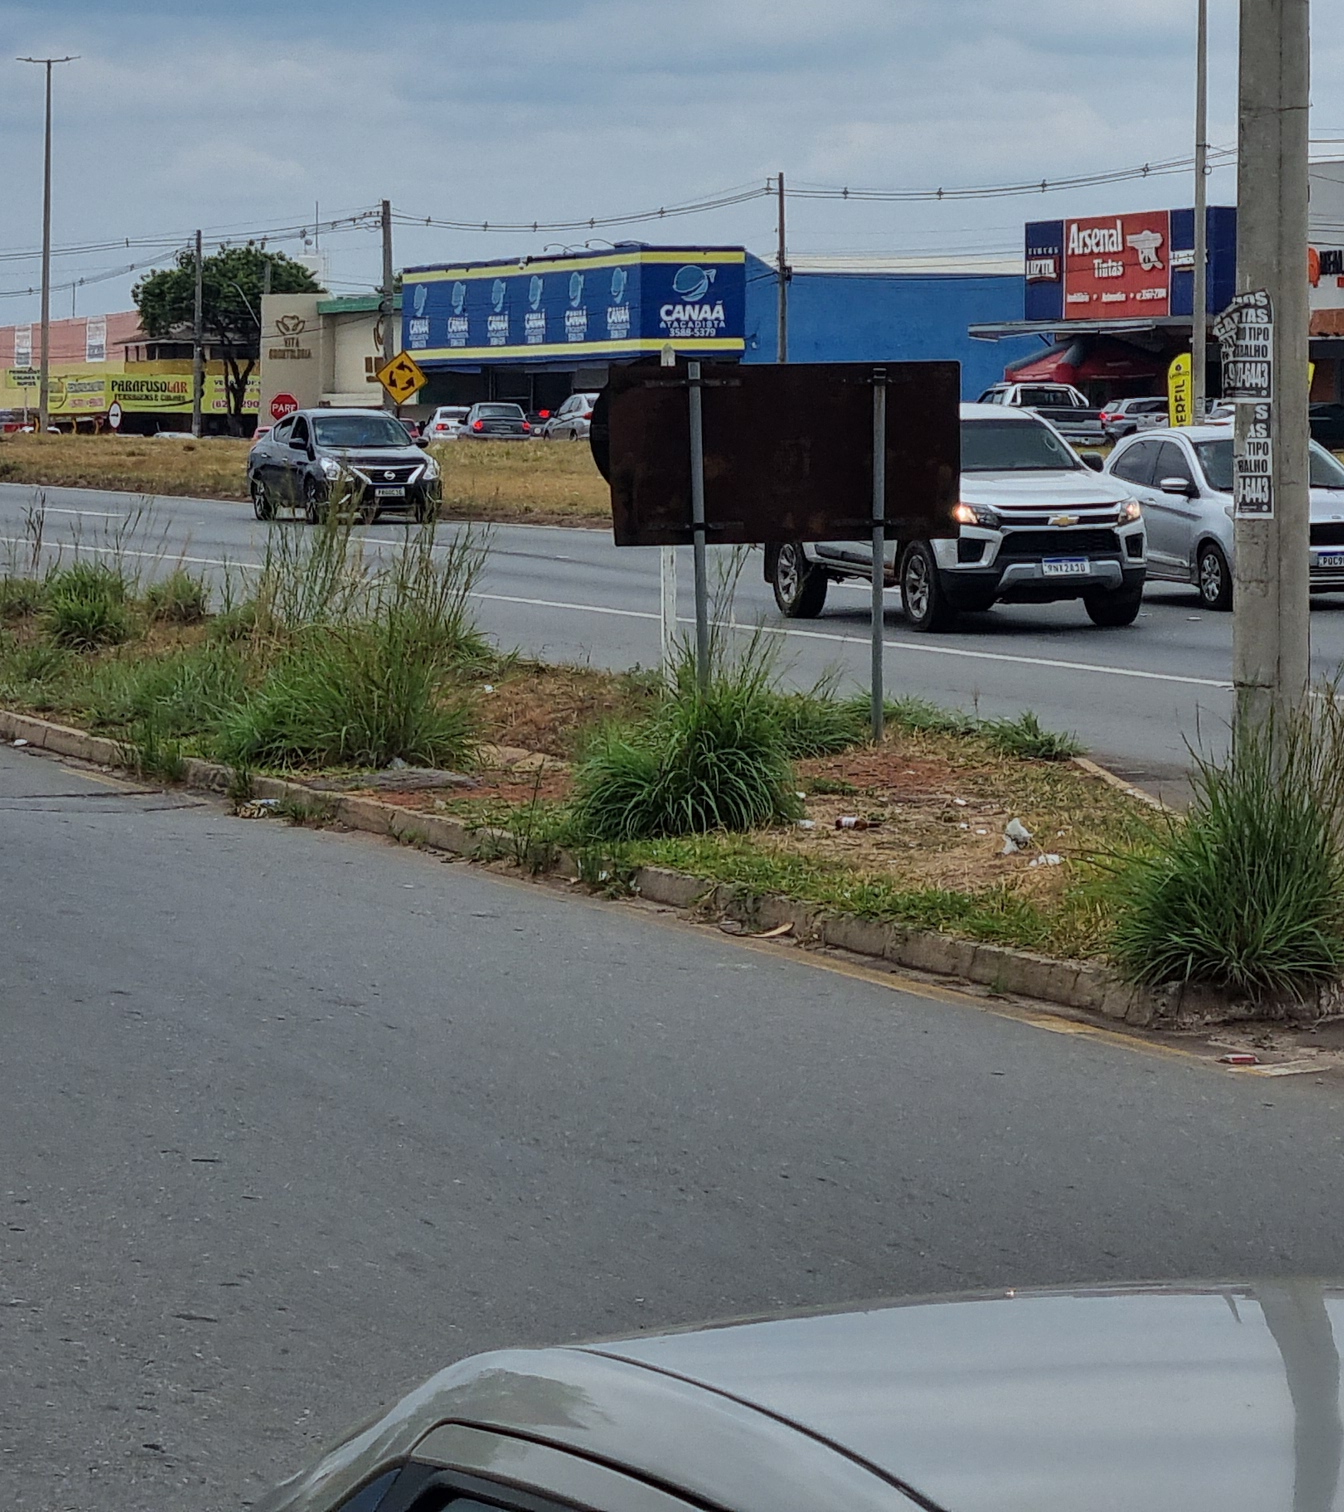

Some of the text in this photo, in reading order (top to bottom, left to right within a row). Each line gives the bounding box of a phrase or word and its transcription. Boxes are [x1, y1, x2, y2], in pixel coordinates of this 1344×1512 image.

[1068, 220, 1123, 255] Arsenal
[1093, 258, 1124, 278] Tintas
[659, 300, 725, 321] CANAÃ
[659, 320, 726, 329] ATACADISTA
[1248, 326, 1270, 342] TIPO
[110, 380, 189, 394] PARAFUSOLAR
[271, 402, 297, 414] PARE
[1174, 379, 1187, 427] ERFIL
[1247, 441, 1269, 457] TIPO
[1237, 458, 1268, 474] BALHO
